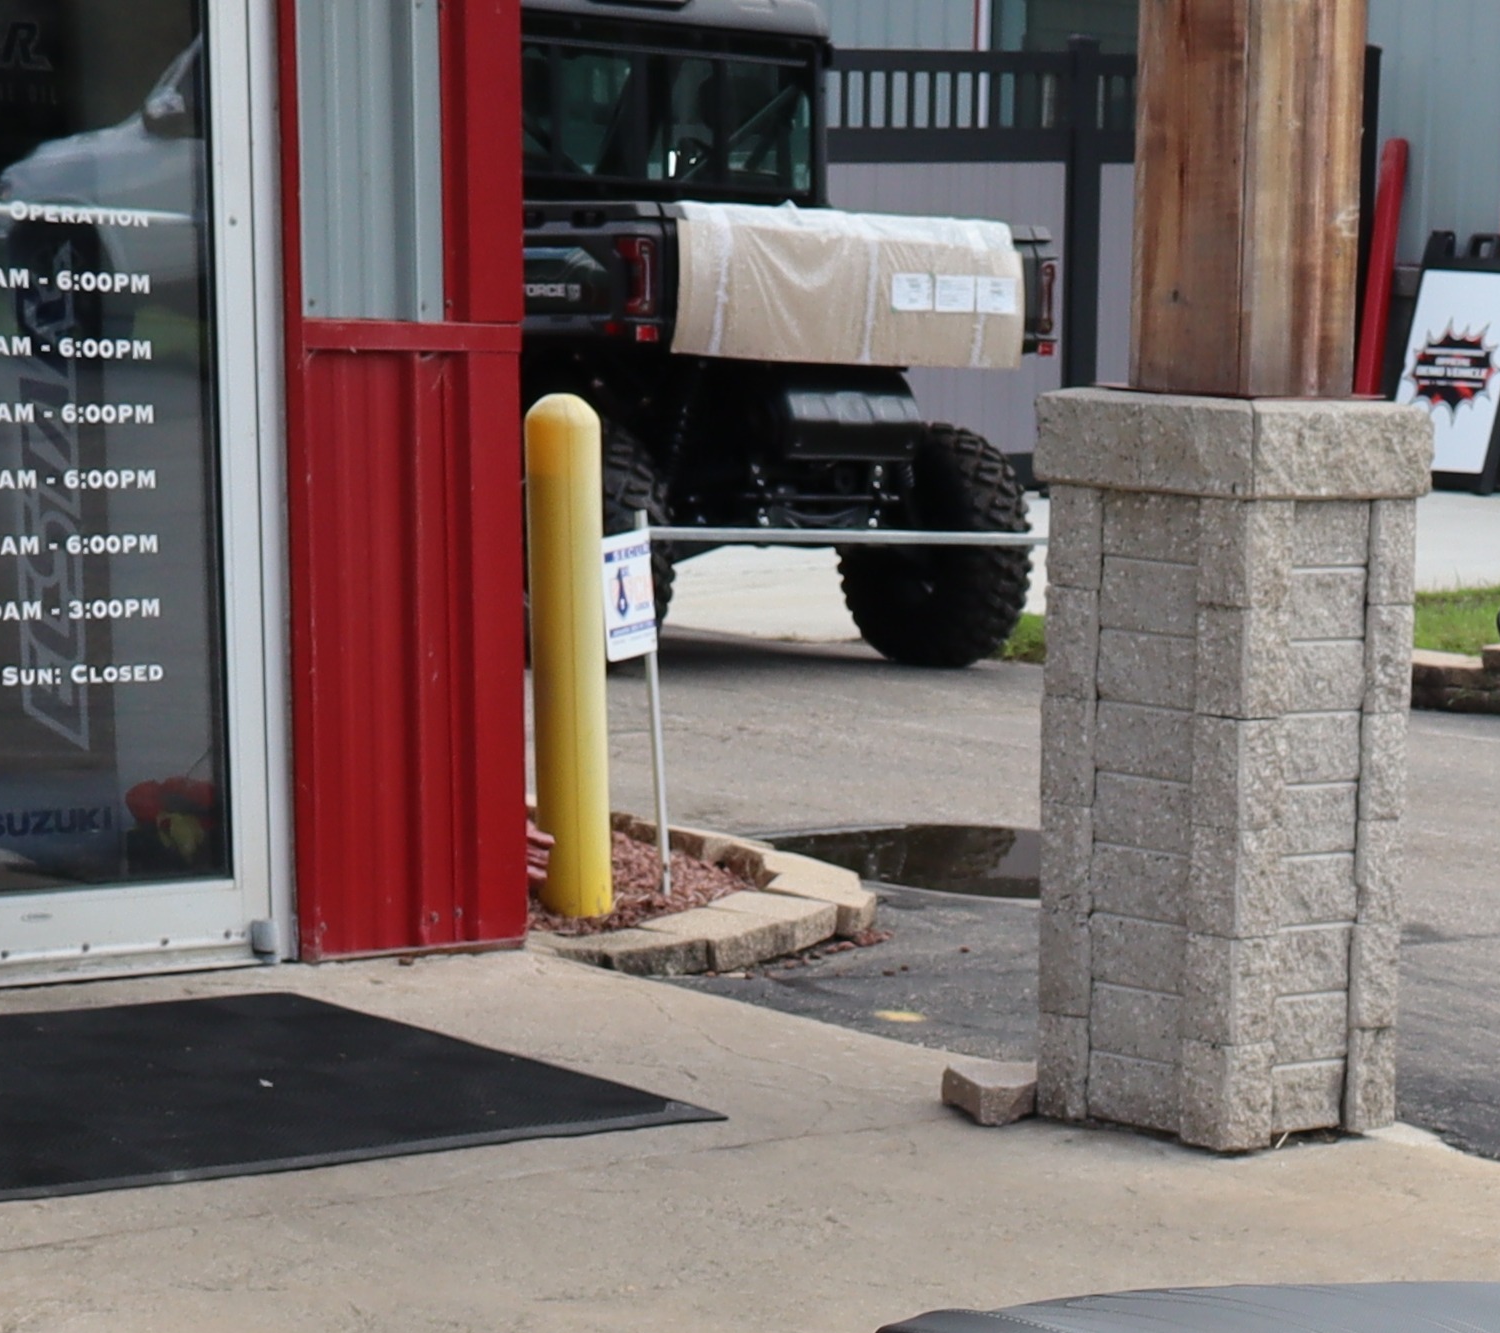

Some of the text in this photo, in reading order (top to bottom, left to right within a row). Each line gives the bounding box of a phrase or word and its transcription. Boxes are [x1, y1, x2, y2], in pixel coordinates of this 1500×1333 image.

[10, 200, 150, 228] OPERATION
[56, 270, 151, 294] 6:00PM
[59, 338, 152, 360] 6:00PM
[61, 403, 155, 424] 6:00PM
[63, 469, 157, 490] 6:00PM
[66, 534, 159, 555] 6:00PM
[68, 598, 160, 619] 3:00PM
[2, 664, 164, 686] SUN: CLOSED
